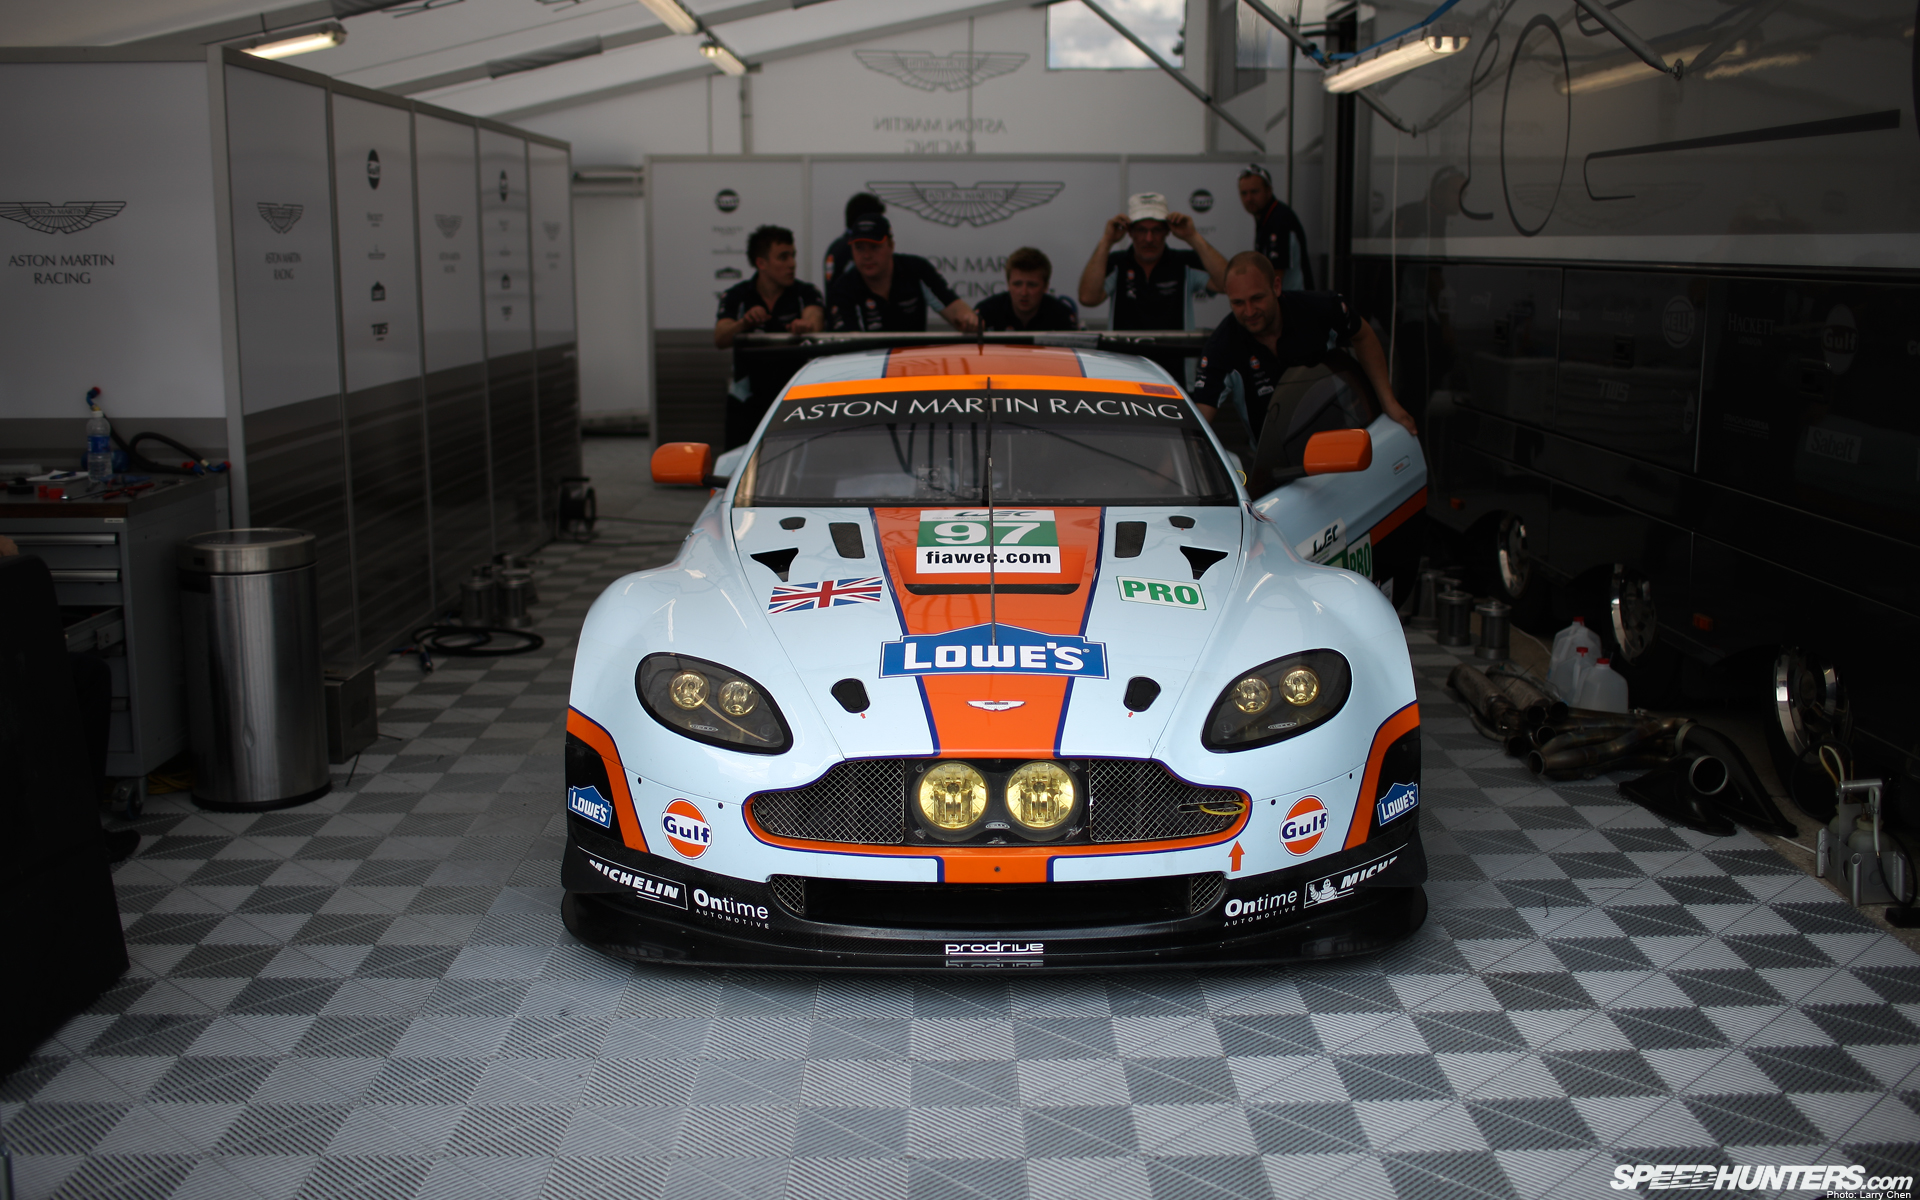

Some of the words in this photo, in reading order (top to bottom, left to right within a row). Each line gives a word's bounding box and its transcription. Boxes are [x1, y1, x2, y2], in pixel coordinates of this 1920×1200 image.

[8, 254, 57, 267] ASTON
[60, 254, 115, 267] MARTIN
[33, 271, 92, 285] RACING
[1664, 311, 1695, 333] HELLA
[1727, 312, 1775, 336] HACKETT
[1823, 328, 1857, 350] Gulf
[783, 399, 898, 422] ASTON
[908, 398, 1039, 414] MARTIN
[1049, 398, 1184, 420] RACING
[1810, 429, 1856, 460] Sabelt
[934, 522, 1041, 544] 97
[926, 551, 1051, 564] fiawec.com
[1349, 541, 1372, 577] PRO
[1123, 579, 1199, 605] PRO
[903, 642, 1085, 670] LOWE'S
[571, 791, 608, 823] LOWE'S
[1381, 789, 1416, 821] LOWE'S
[663, 816, 710, 843] Gulf
[1281, 812, 1327, 839] Gulf
[588, 859, 679, 899] MICHELIN
[693, 889, 769, 920] Ontime
[1224, 890, 1298, 917] Ontime
[695, 908, 770, 930] AUTOMOTIVE
[1224, 905, 1296, 928] AUTOMOTIVE
[945, 941, 1044, 955] prodrive
